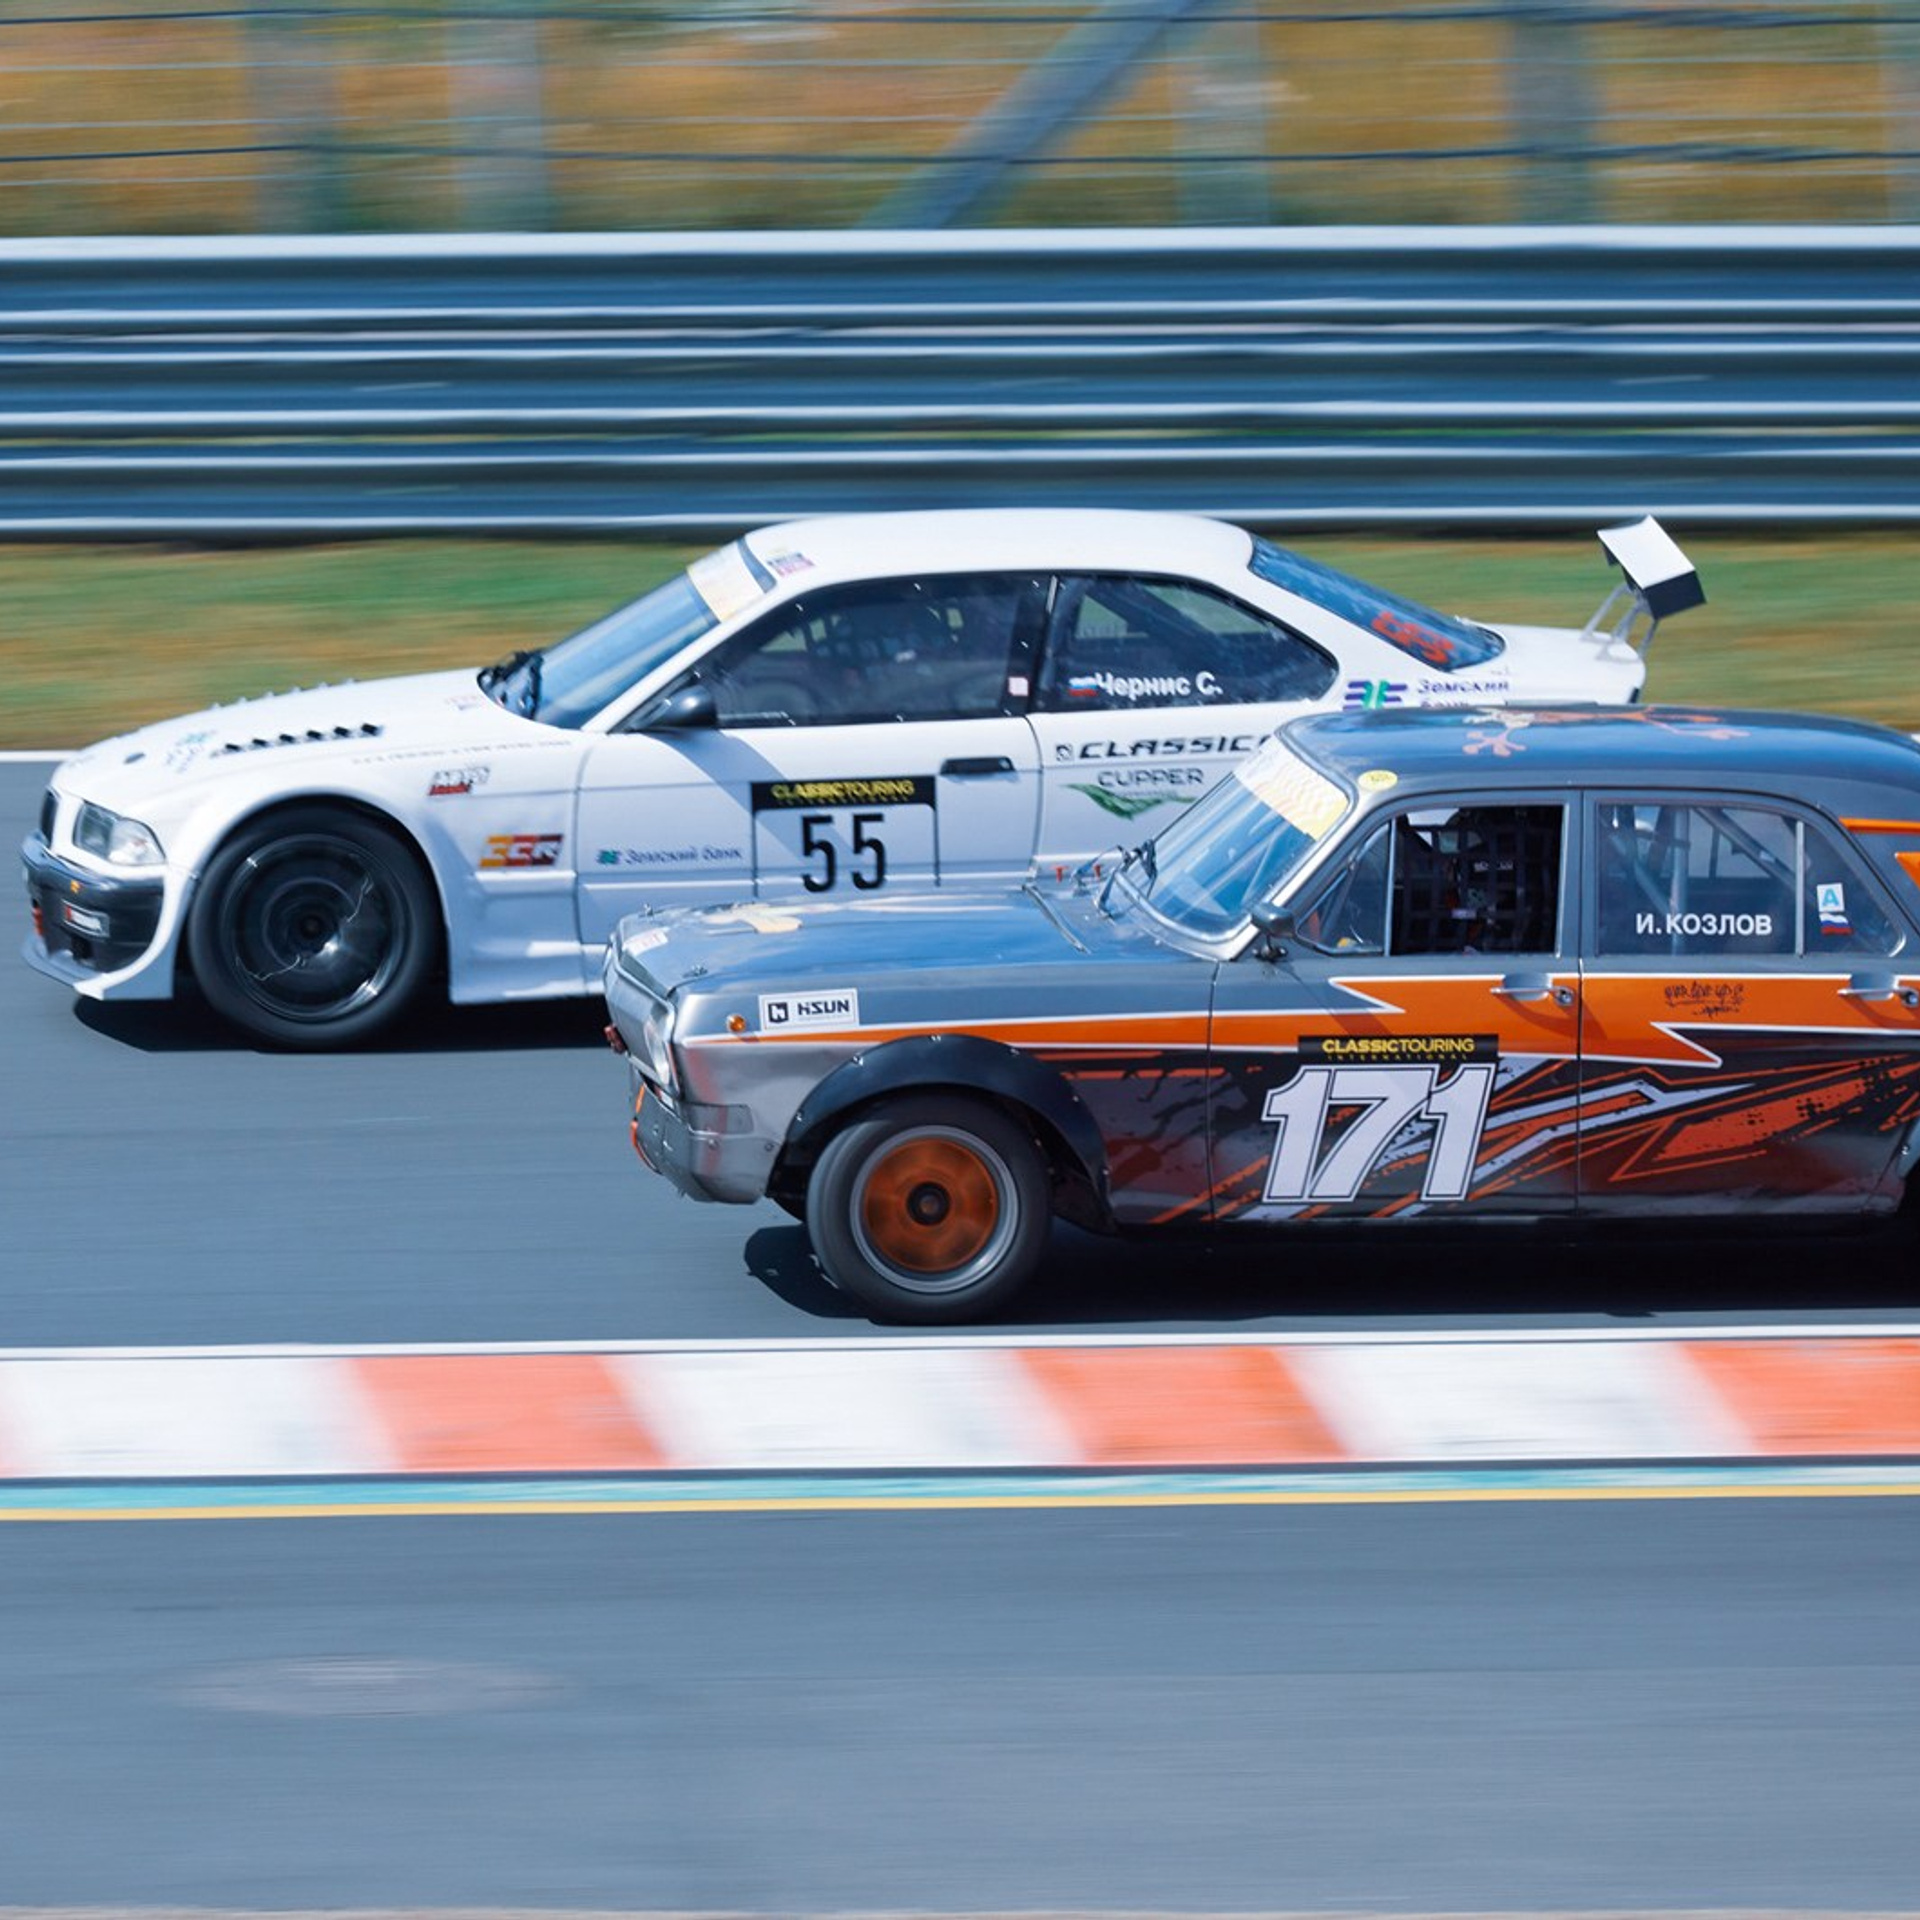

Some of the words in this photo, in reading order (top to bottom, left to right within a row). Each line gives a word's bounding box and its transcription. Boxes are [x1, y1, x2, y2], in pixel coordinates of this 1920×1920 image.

[1095, 672, 1190, 700] Чернис
[1098, 768, 1204, 787] CUPPER
[802, 813, 885, 892] 55
[1636, 913, 1661, 934] И.
[1666, 913, 1772, 936] КОЗЛОВ
[797, 999, 850, 1015] HSUN
[1322, 1038, 1475, 1054] CLASSICTOURING
[1261, 1063, 1496, 1202] 171
